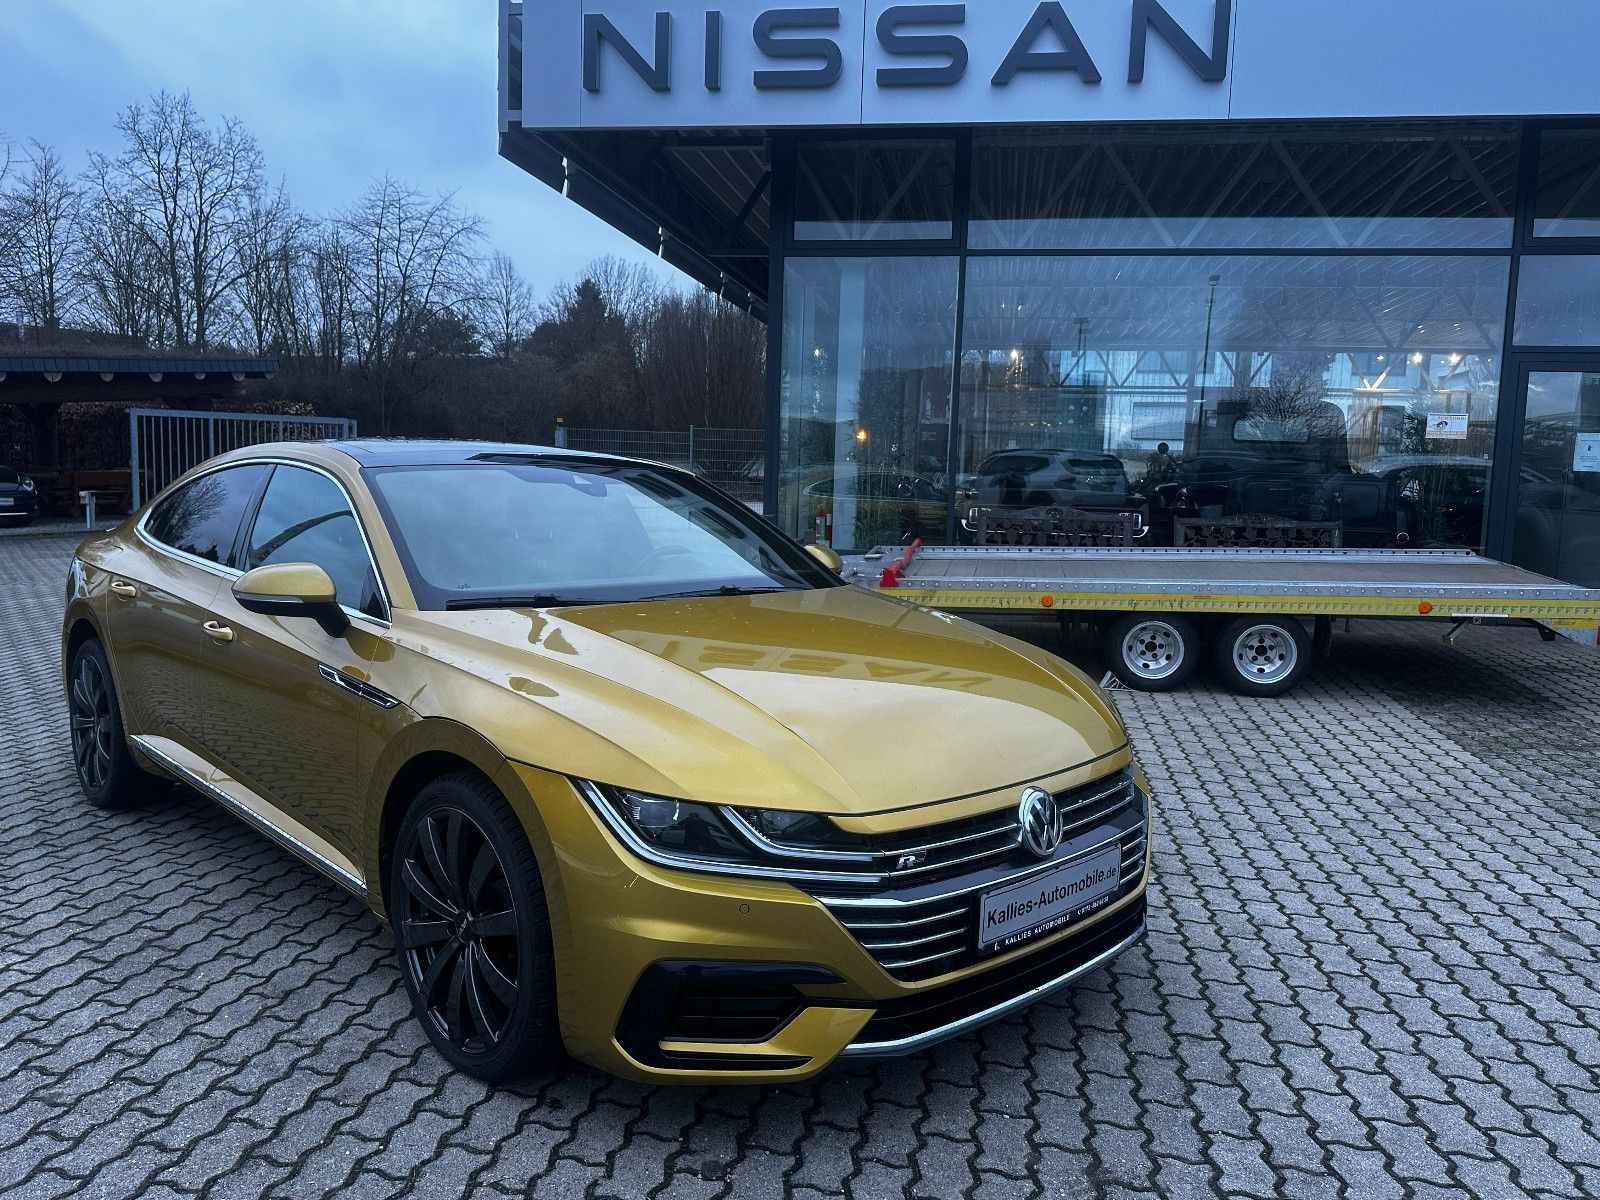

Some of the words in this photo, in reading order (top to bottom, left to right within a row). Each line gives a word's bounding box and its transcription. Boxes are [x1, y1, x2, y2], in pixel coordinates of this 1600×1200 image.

[583, 0, 1228, 92] NISSAN
[987, 866, 1117, 928] Kallies-Automobile.de
[1005, 931, 1032, 946] KALLIES
[1034, 914, 1071, 935] AUTOMOBILE
